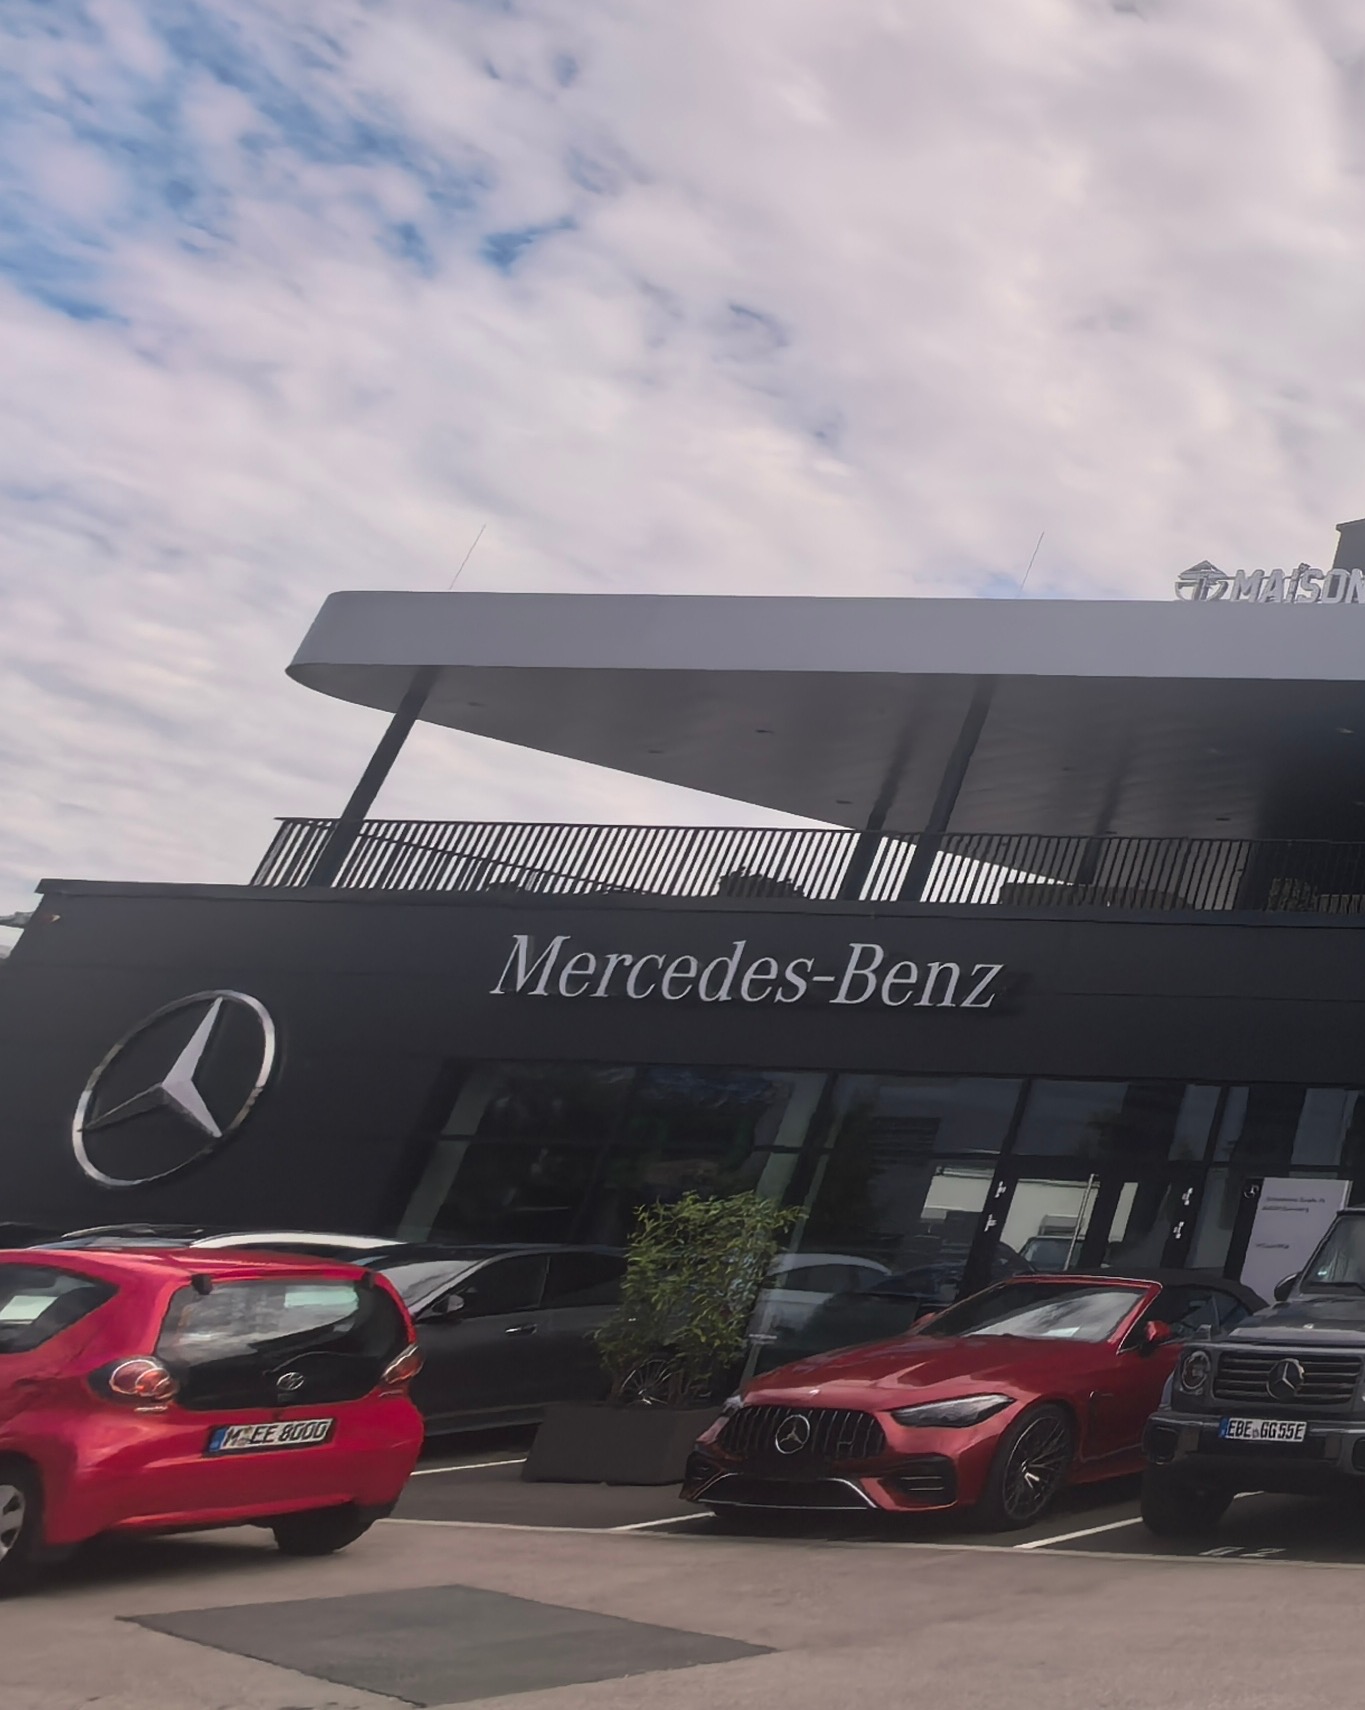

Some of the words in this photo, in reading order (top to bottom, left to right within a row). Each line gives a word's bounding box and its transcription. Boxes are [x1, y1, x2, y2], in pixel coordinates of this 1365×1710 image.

[489, 934, 1005, 1009] Mercedes-Benz
[223, 1427, 241, 1447] M
[278, 1421, 329, 1442] 8000
[1227, 1420, 1253, 1438] EBE
